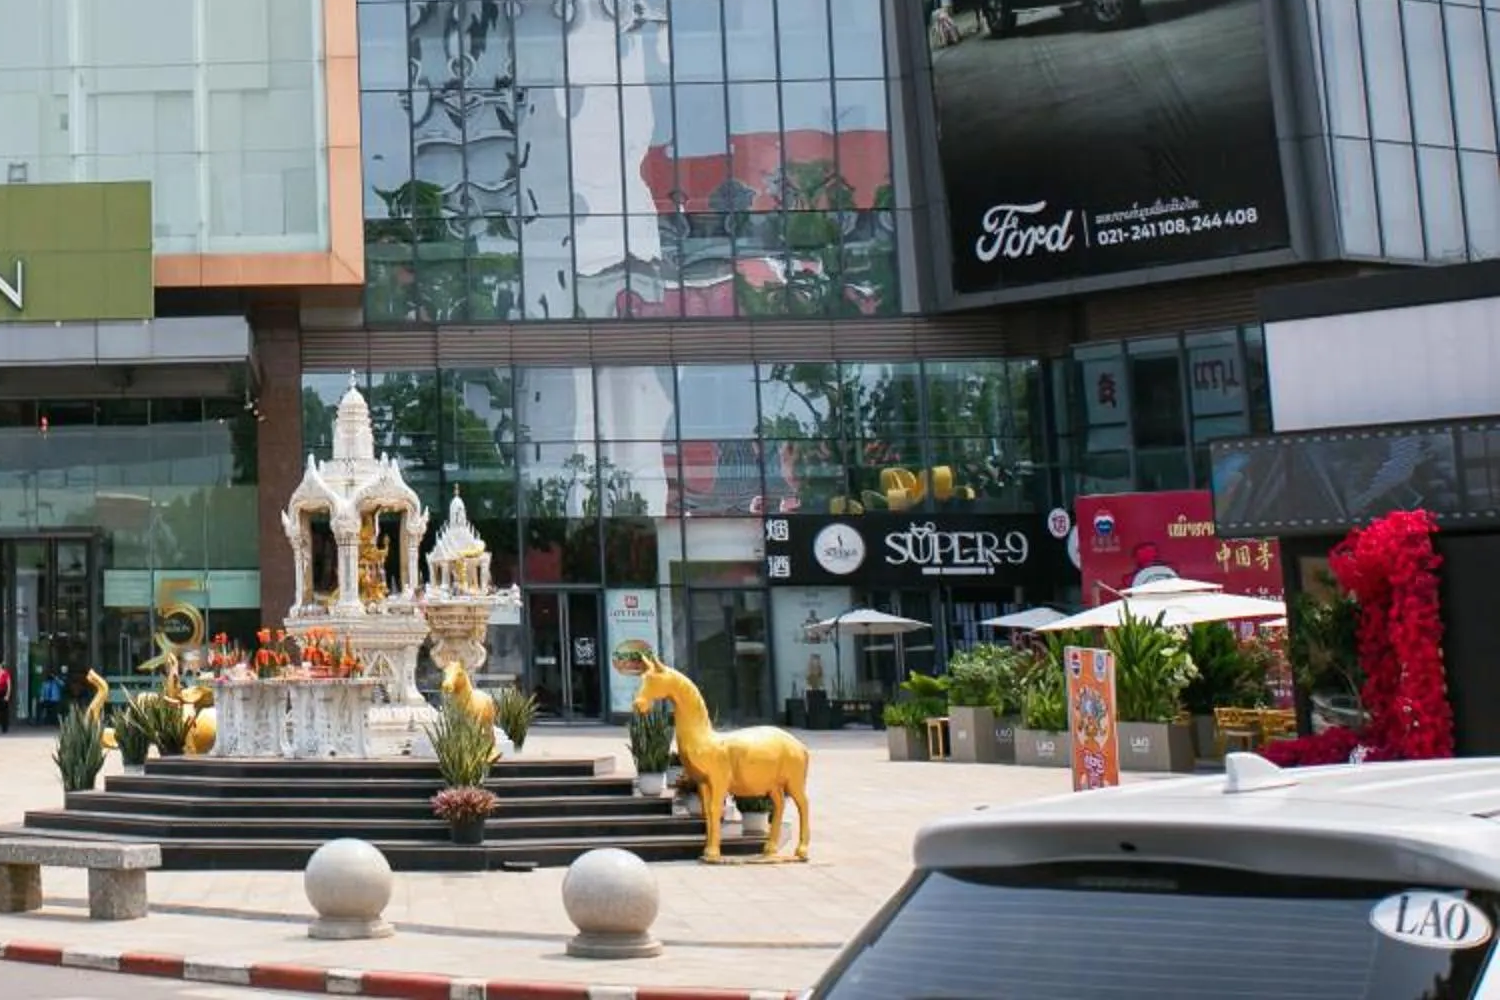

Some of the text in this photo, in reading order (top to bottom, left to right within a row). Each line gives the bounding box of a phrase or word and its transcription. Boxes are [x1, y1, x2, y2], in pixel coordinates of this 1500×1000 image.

[976, 200, 1074, 262] Ford
[884, 521, 1029, 567] SUPER-9
[1393, 895, 1471, 941] LAO
